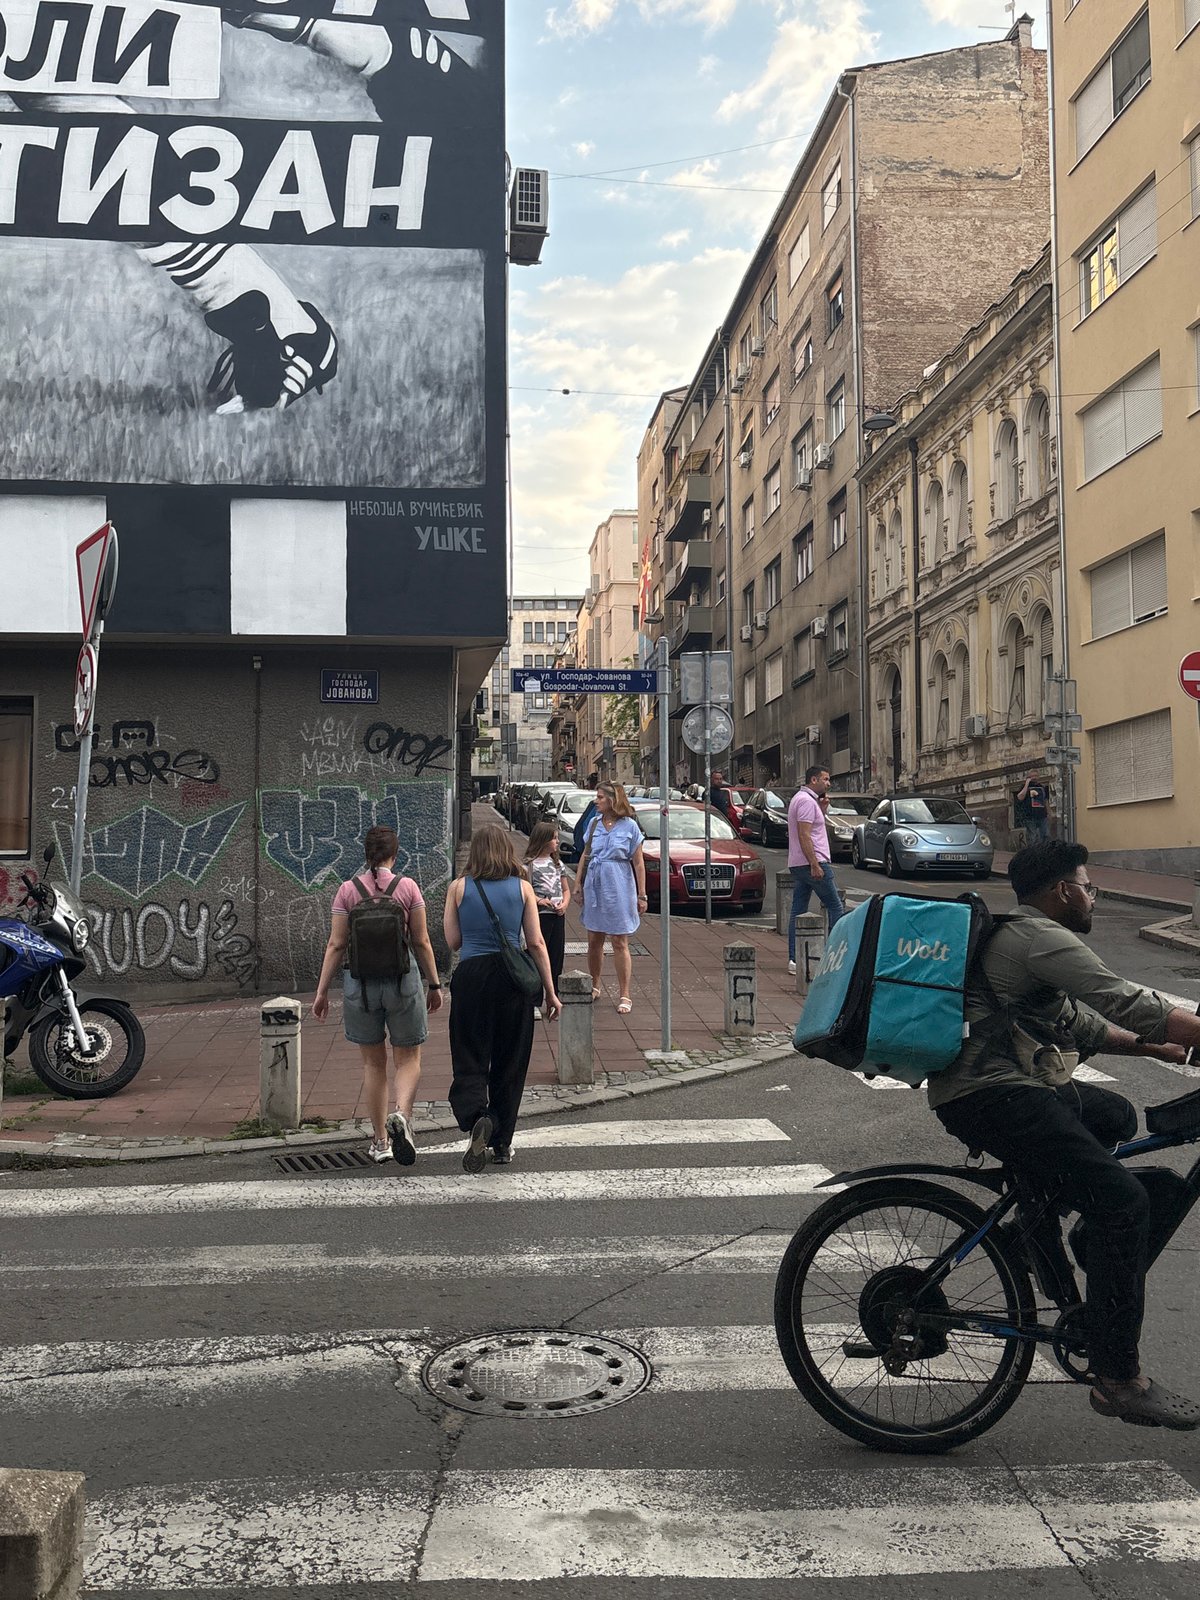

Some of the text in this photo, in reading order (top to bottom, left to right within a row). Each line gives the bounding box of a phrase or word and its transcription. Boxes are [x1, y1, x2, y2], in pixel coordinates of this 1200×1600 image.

[0, 1, 180, 86] ЛИ
[350, 500, 405, 516] НЕБОЈША
[414, 526, 487, 553] УШКЕ
[540, 672, 632, 682] ул. Господар-Јованова
[326, 688, 373, 699] ЈОВАНОВА
[543, 683, 615, 692] Gospodar-Jovanova
[618, 683, 629, 691] St.
[897, 937, 951, 962] Wolt
